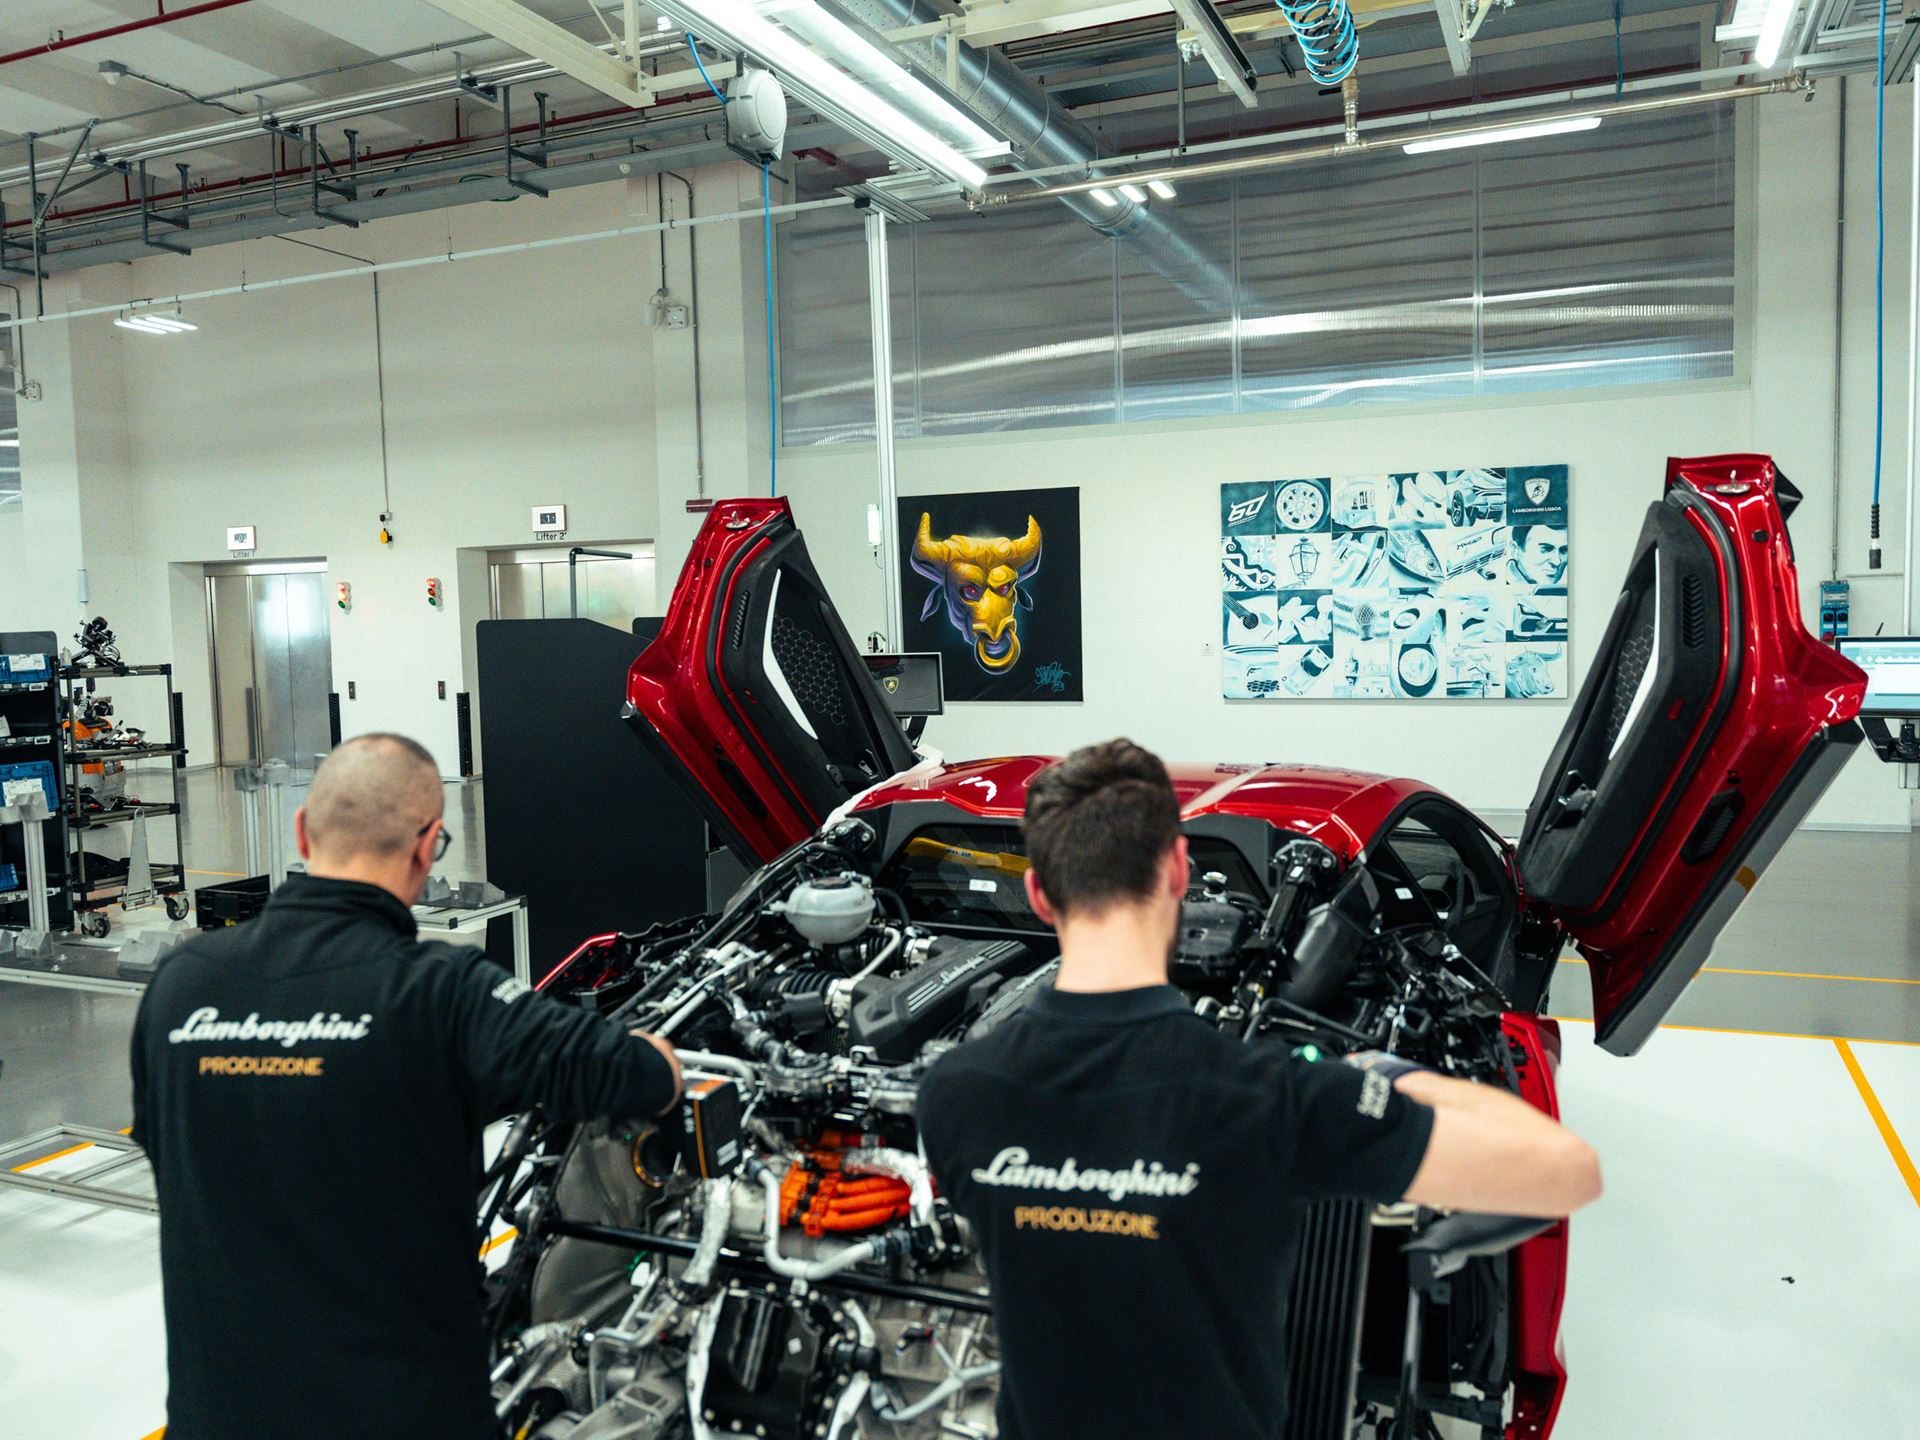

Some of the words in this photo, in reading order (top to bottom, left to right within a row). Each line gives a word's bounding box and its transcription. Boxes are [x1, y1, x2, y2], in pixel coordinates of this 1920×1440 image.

[536, 532, 557, 541] Lifter
[168, 1006, 373, 1048] Lamborghini
[199, 1055, 325, 1076] PRODUZIONE
[971, 1146, 1200, 1202] Lamborghini
[1014, 1206, 1161, 1240] PRODUZIONE
